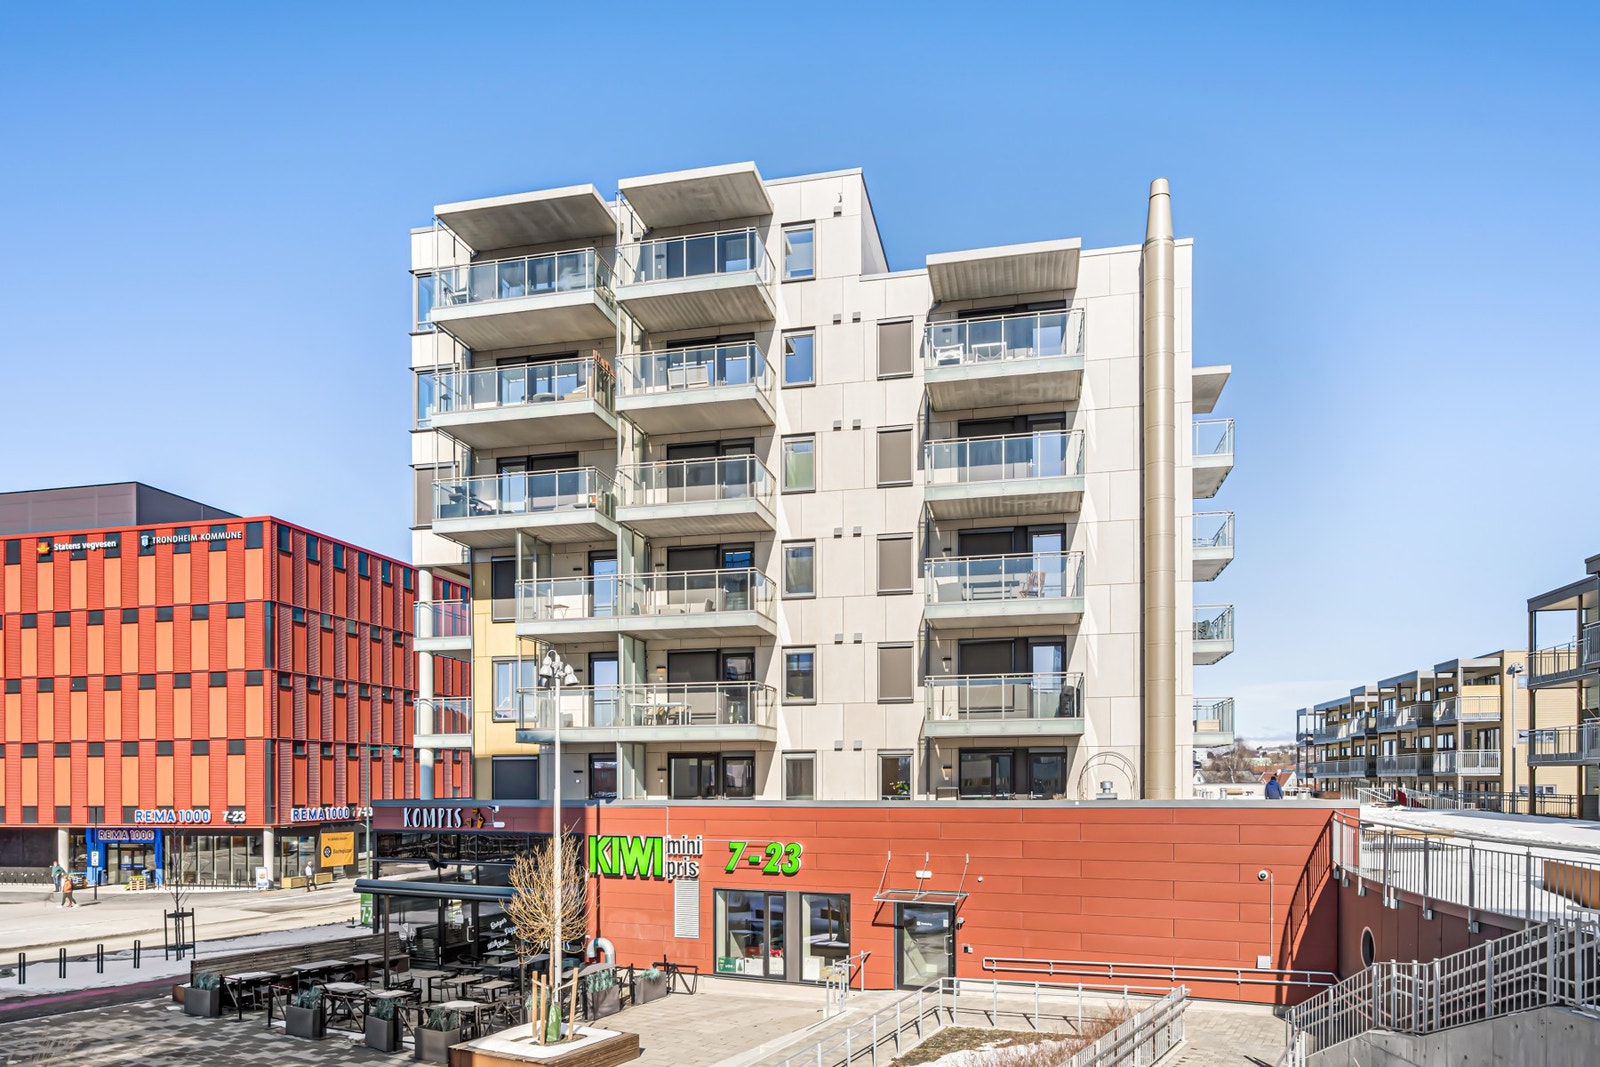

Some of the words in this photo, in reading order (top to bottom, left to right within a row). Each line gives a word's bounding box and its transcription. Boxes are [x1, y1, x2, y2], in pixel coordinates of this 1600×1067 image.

[152, 534, 198, 544] TRONDHEIM
[200, 531, 242, 541] KOMMUNE
[53, 543, 81, 551] Statens
[82, 541, 117, 551] vegvesen
[134, 809, 176, 823] REMA
[179, 808, 212, 823] 1000
[222, 810, 246, 822] 7-23
[291, 807, 325, 822] REMA
[325, 806, 350, 820] 1000
[403, 807, 463, 829] KOMPIS
[98, 830, 128, 840] REMA
[130, 829, 154, 840] 1000
[588, 836, 664, 877] KIWI
[667, 835, 703, 855] mini
[725, 842, 803, 876] 7-23
[667, 856, 700, 880] pris
[361, 906, 373, 923] 7-2
